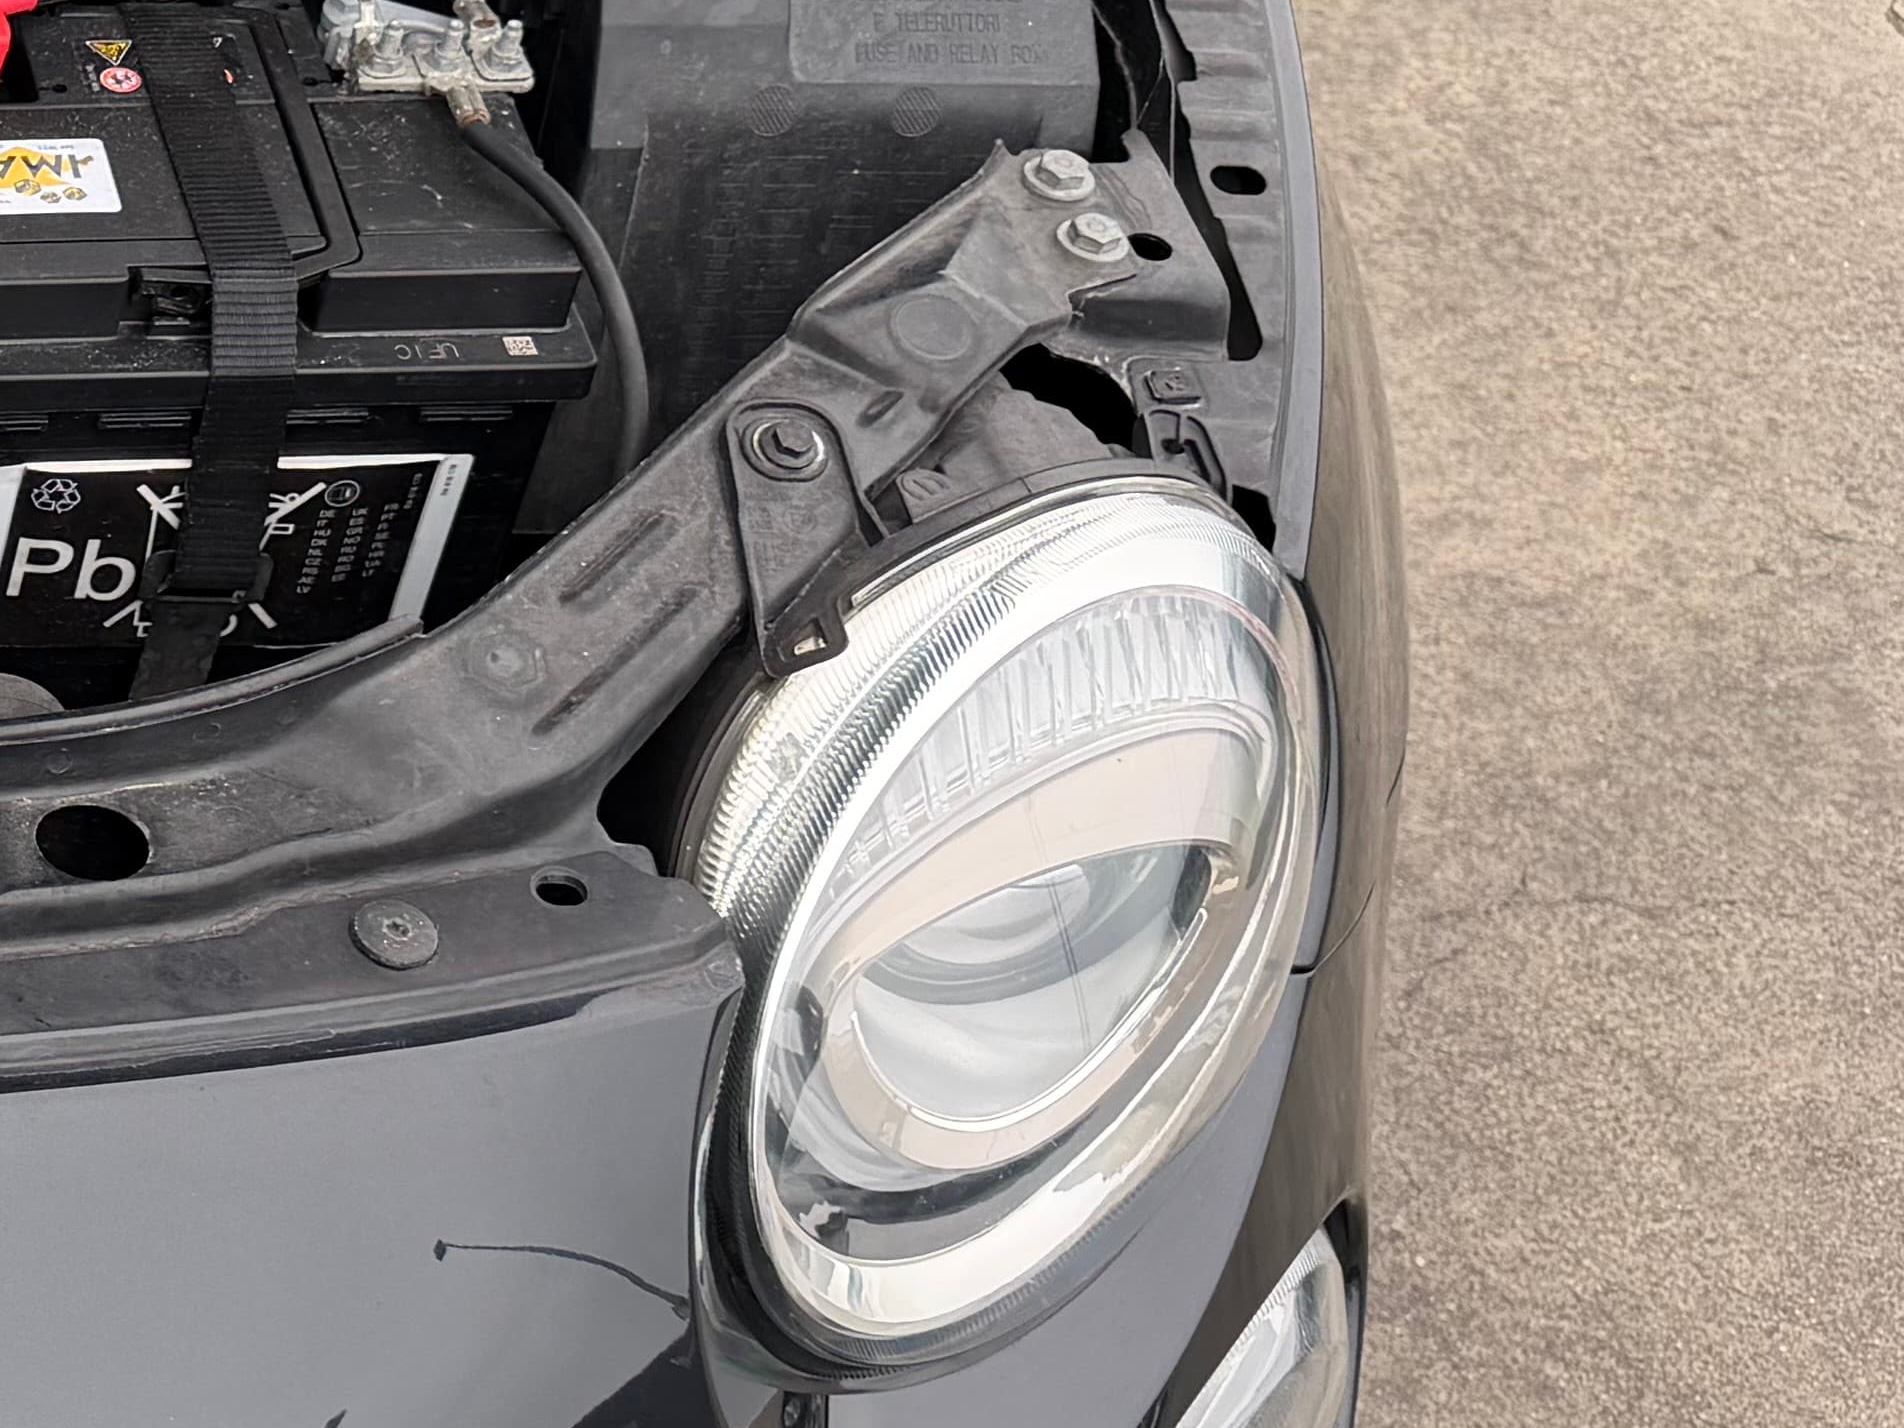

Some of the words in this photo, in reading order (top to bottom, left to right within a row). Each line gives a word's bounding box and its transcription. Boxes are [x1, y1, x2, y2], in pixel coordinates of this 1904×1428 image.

[855, 42, 898, 64] FUSE
[907, 43, 939, 64] AND
[949, 43, 1000, 64] RELAY
[5, 537, 137, 602] Pb
